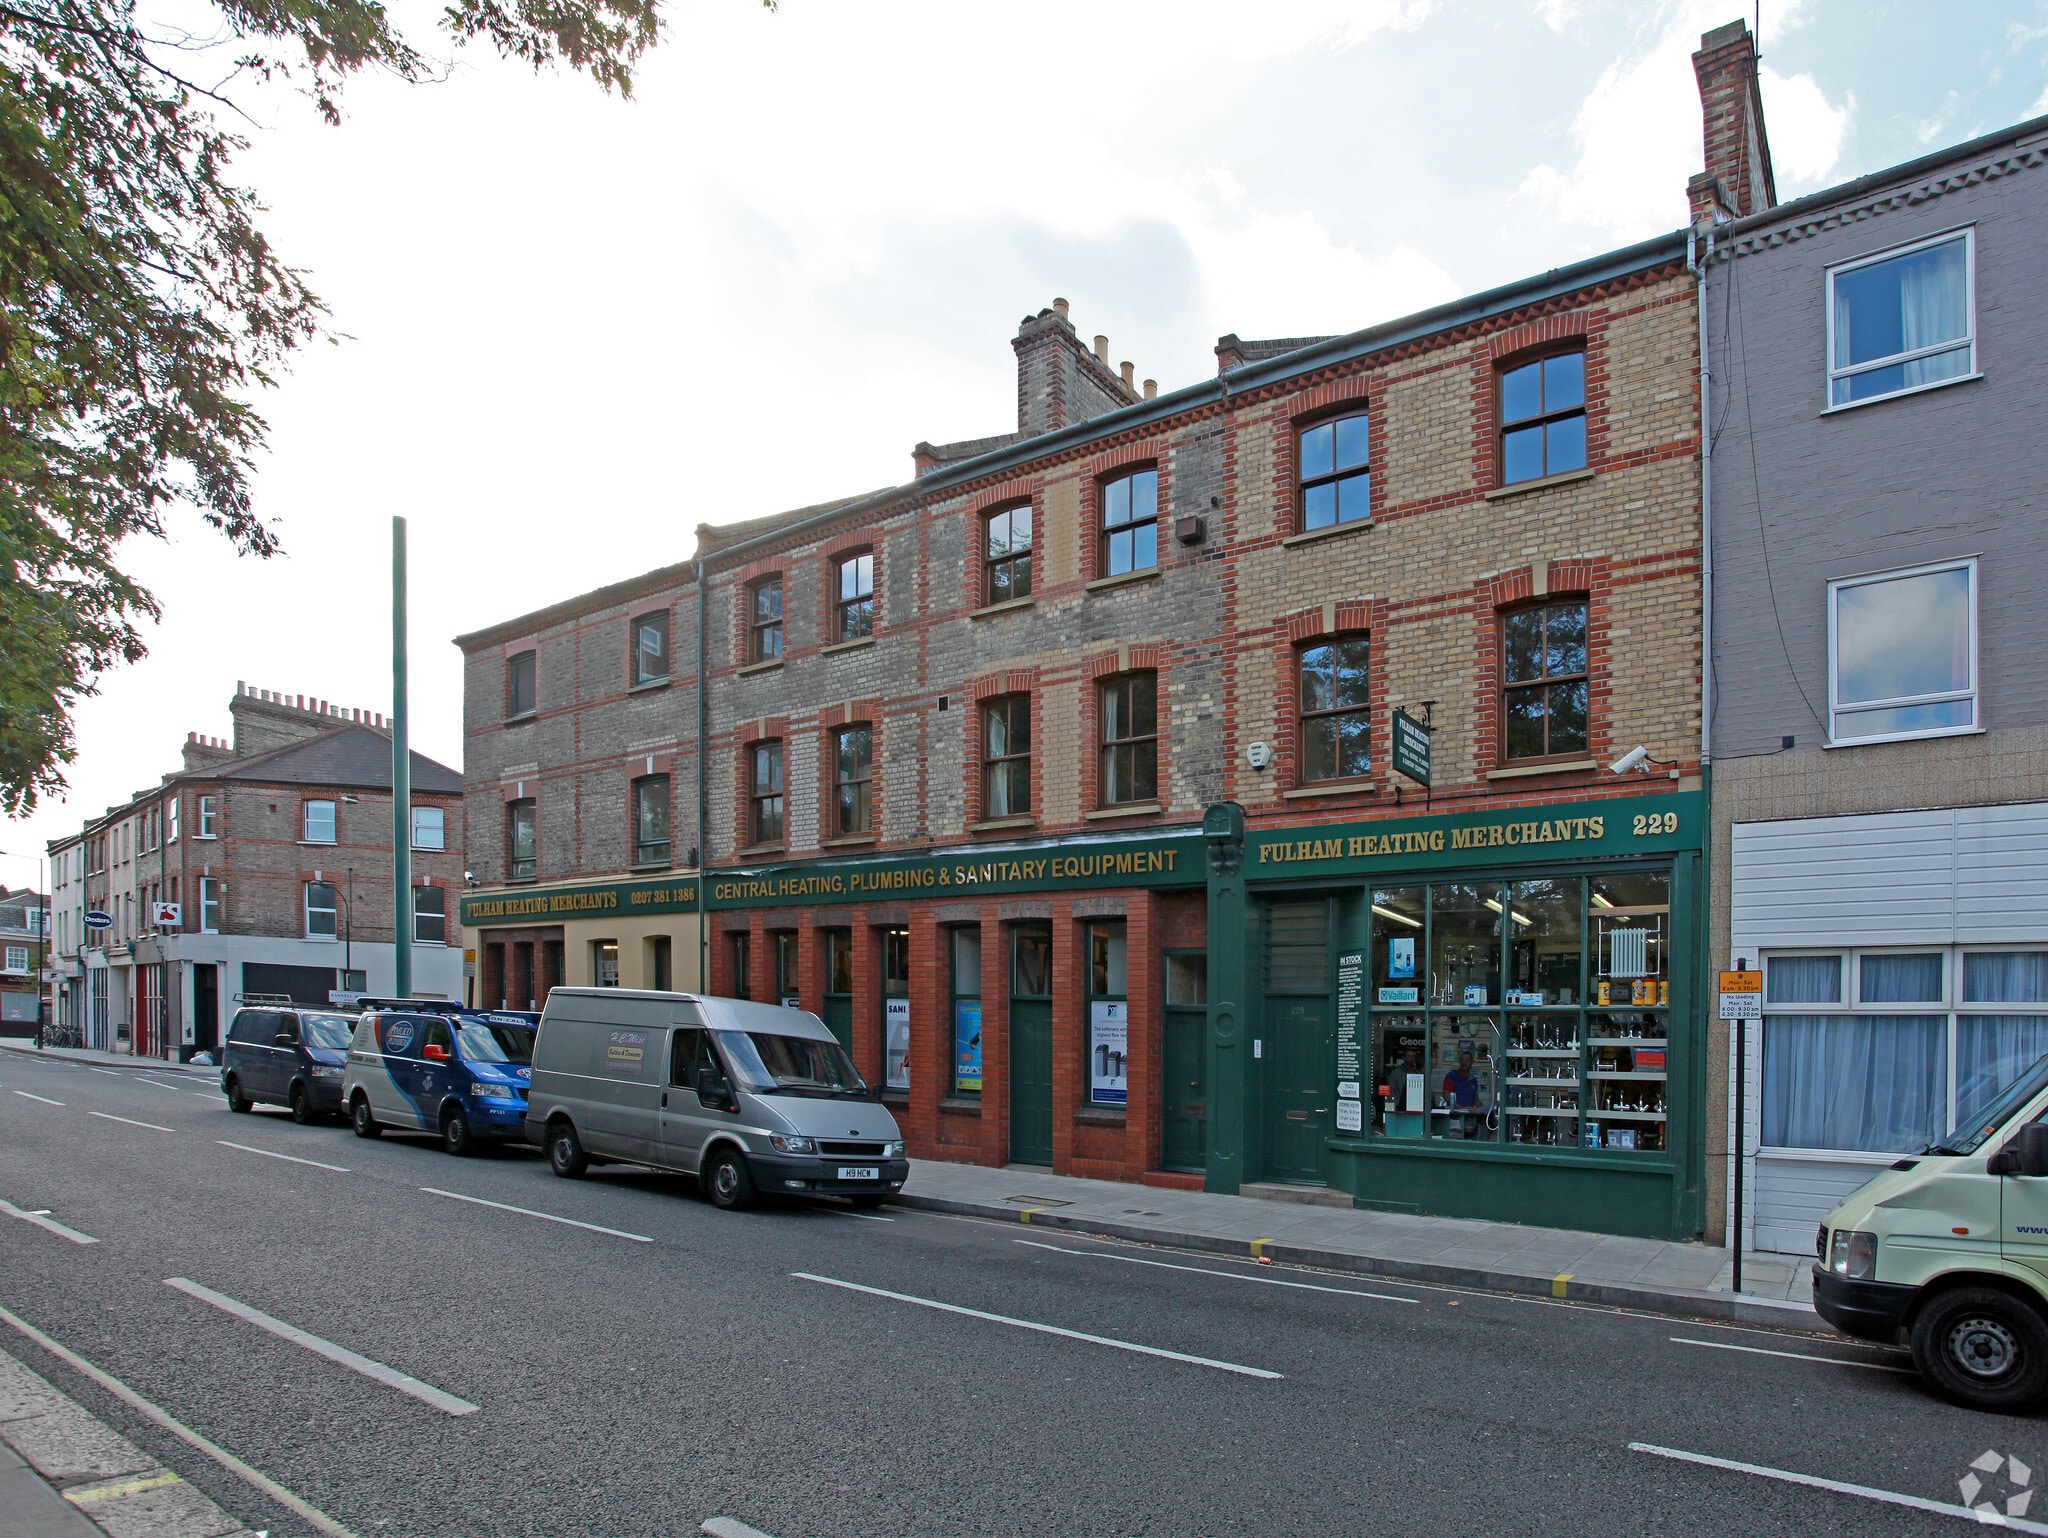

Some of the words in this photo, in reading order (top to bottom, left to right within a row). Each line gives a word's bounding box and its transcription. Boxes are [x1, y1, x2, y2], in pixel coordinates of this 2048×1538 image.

[1259, 838, 1343, 864] FULHAM
[1348, 830, 1445, 857] HEATING
[1451, 816, 1604, 849] MERCHANTS
[1632, 812, 1678, 836] 229
[715, 880, 776, 900] CENTRAL
[779, 875, 847, 896] HEATING,
[850, 868, 934, 891] PLUMBING
[938, 867, 950, 886] &
[954, 859, 1048, 885] SANITARY
[1052, 850, 1178, 878] EQUIPMENT
[467, 901, 506, 918] FULHAM
[506, 896, 548, 915] HEATING
[550, 891, 618, 912] MERCHANTS
[630, 892, 651, 905] 0207
[654, 890, 671, 903] 381
[672, 888, 695, 902] 1386
[1388, 991, 1416, 1000] Vaillant
[846, 1169, 855, 1177] H9
